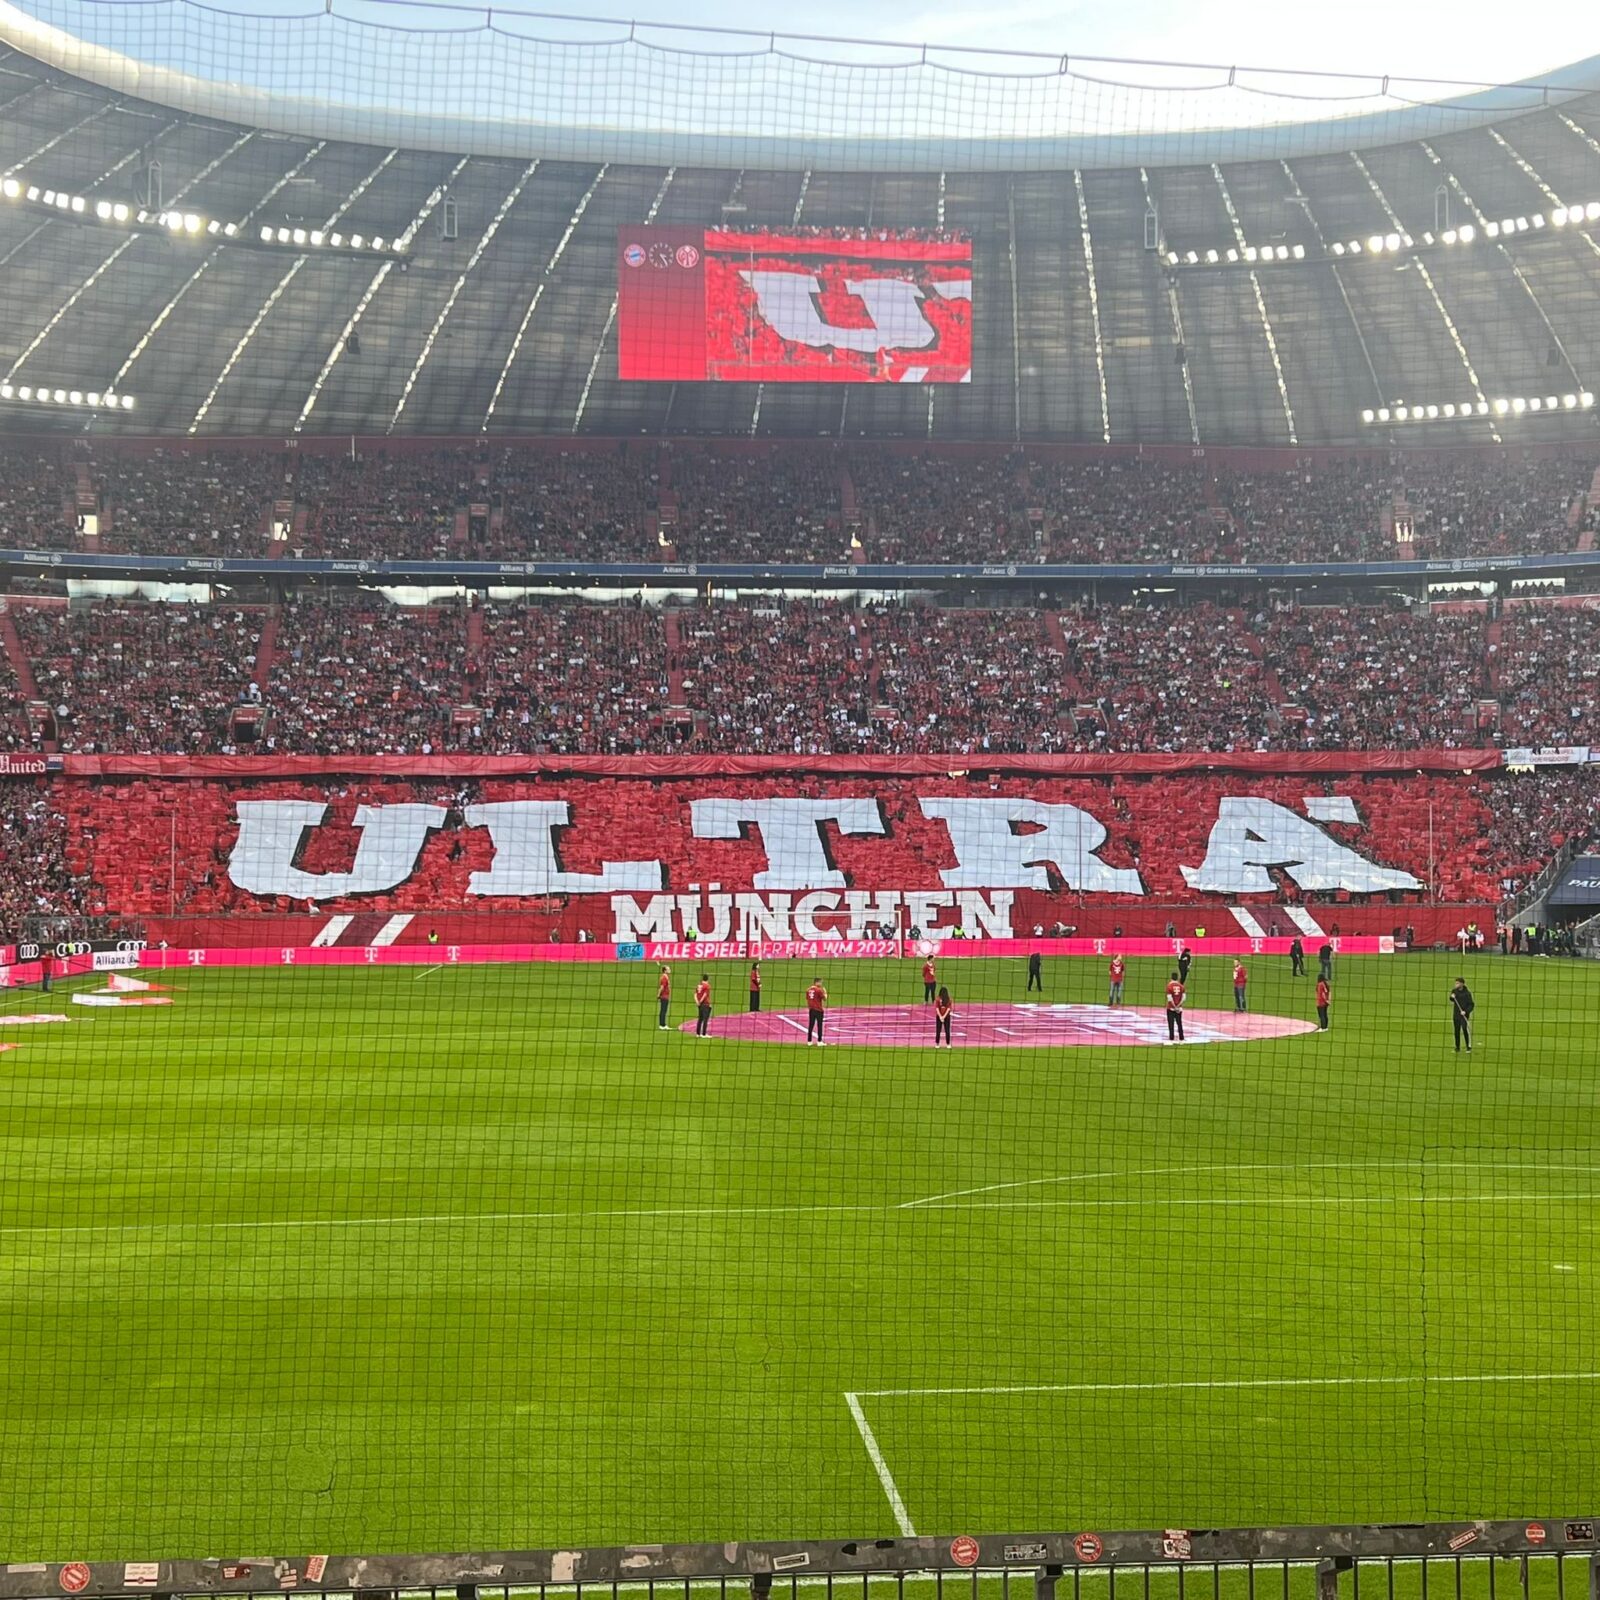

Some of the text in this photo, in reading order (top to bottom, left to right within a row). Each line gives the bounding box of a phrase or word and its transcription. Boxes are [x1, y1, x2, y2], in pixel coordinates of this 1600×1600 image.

[23, 553, 50, 562] Allianz
[186, 560, 213, 569] Allianz
[332, 562, 358, 571] Allianz
[499, 564, 524, 572] Allianz
[1463, 560, 1487, 569] Global
[662, 566, 687, 574] Allianz
[823, 566, 848, 575] Allianz
[0, 754, 46, 774] United
[227, 796, 1424, 900] ULTRA
[610, 882, 1014, 942] MÜNCHEN
[651, 942, 690, 959] ALLE
[693, 942, 747, 959] SPIELE
[785, 940, 818, 956] FIFA
[96, 955, 125, 966] Allianz
